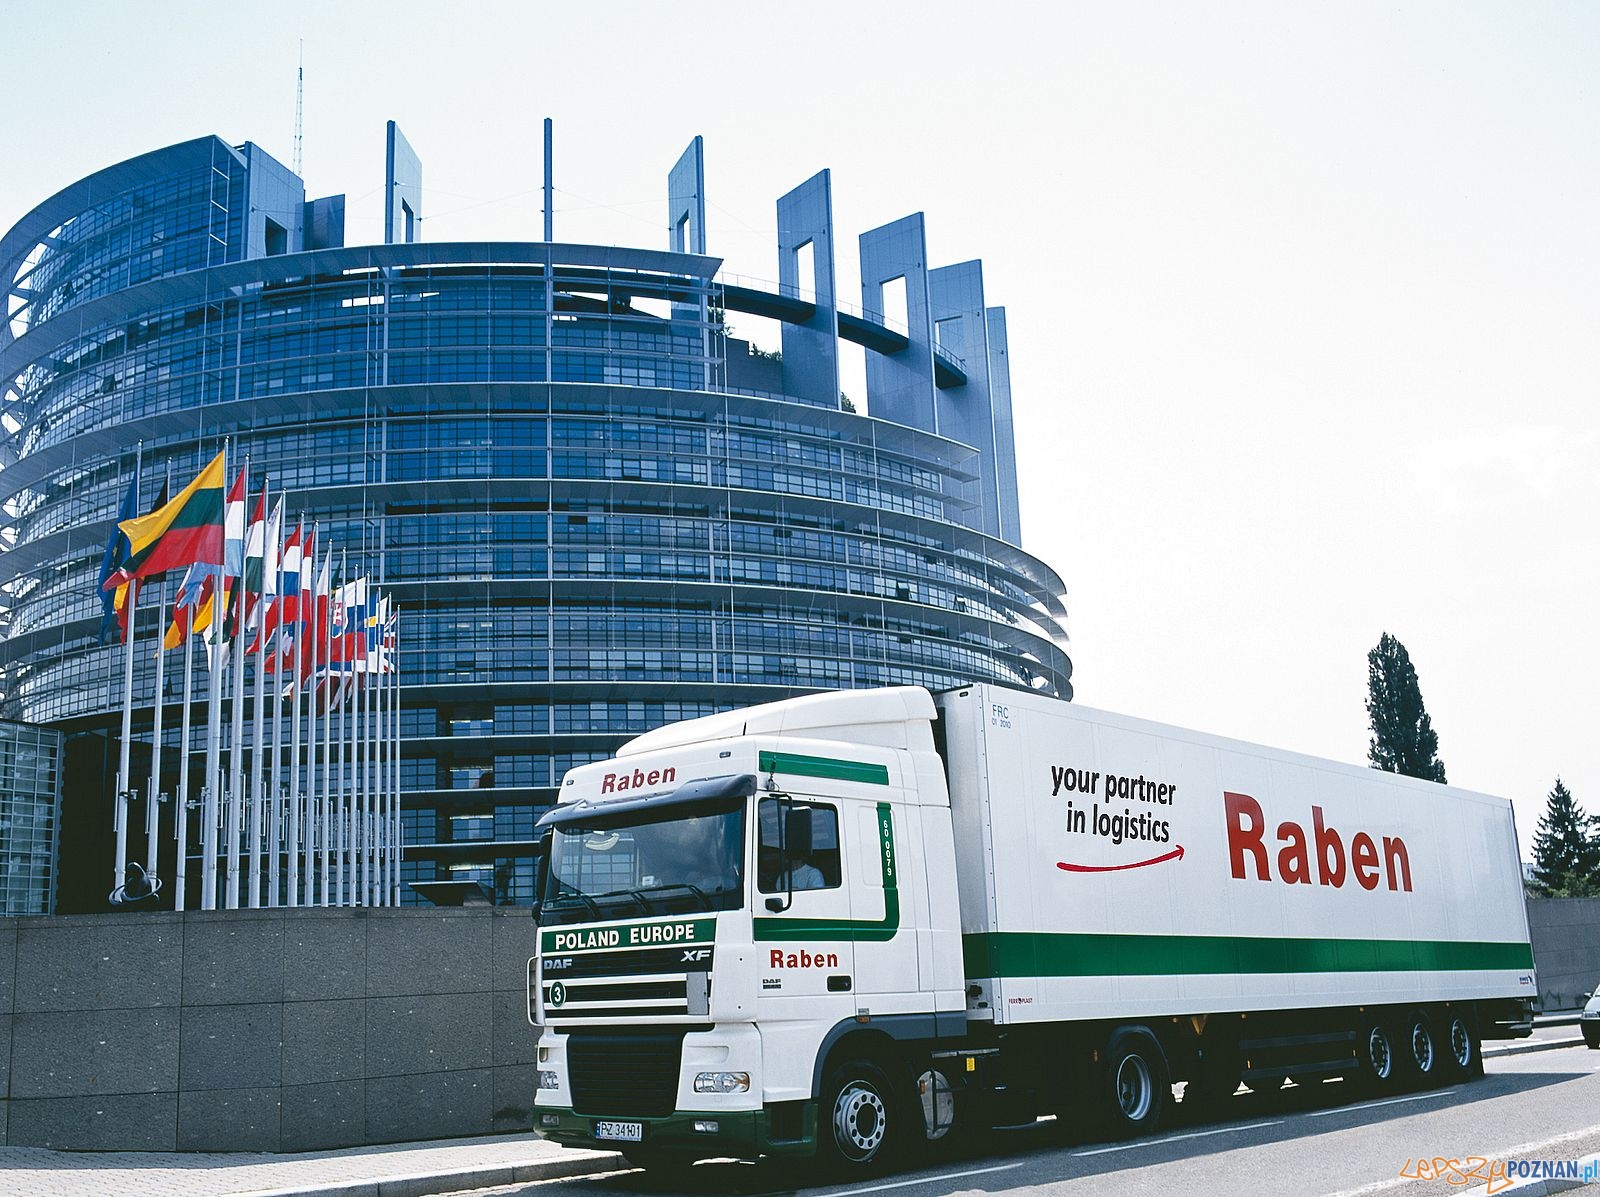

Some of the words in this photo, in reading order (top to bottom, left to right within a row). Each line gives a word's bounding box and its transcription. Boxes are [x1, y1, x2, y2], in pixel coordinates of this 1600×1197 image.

[992, 704, 1009, 719] FRC
[601, 766, 676, 794] Raben
[1051, 765, 1100, 797] your
[1105, 772, 1176, 806] partner
[883, 820, 889, 837] 60
[1066, 801, 1087, 833] in
[1092, 804, 1170, 845] logistics
[1223, 791, 1413, 893] Raben
[555, 930, 620, 950] POLAND
[630, 924, 695, 944] EUROPE
[544, 958, 573, 970] DAF
[680, 950, 712, 962] XF
[770, 949, 838, 969] Raben
[554, 985, 562, 1003] 3
[601, 1122, 613, 1136] PZ
